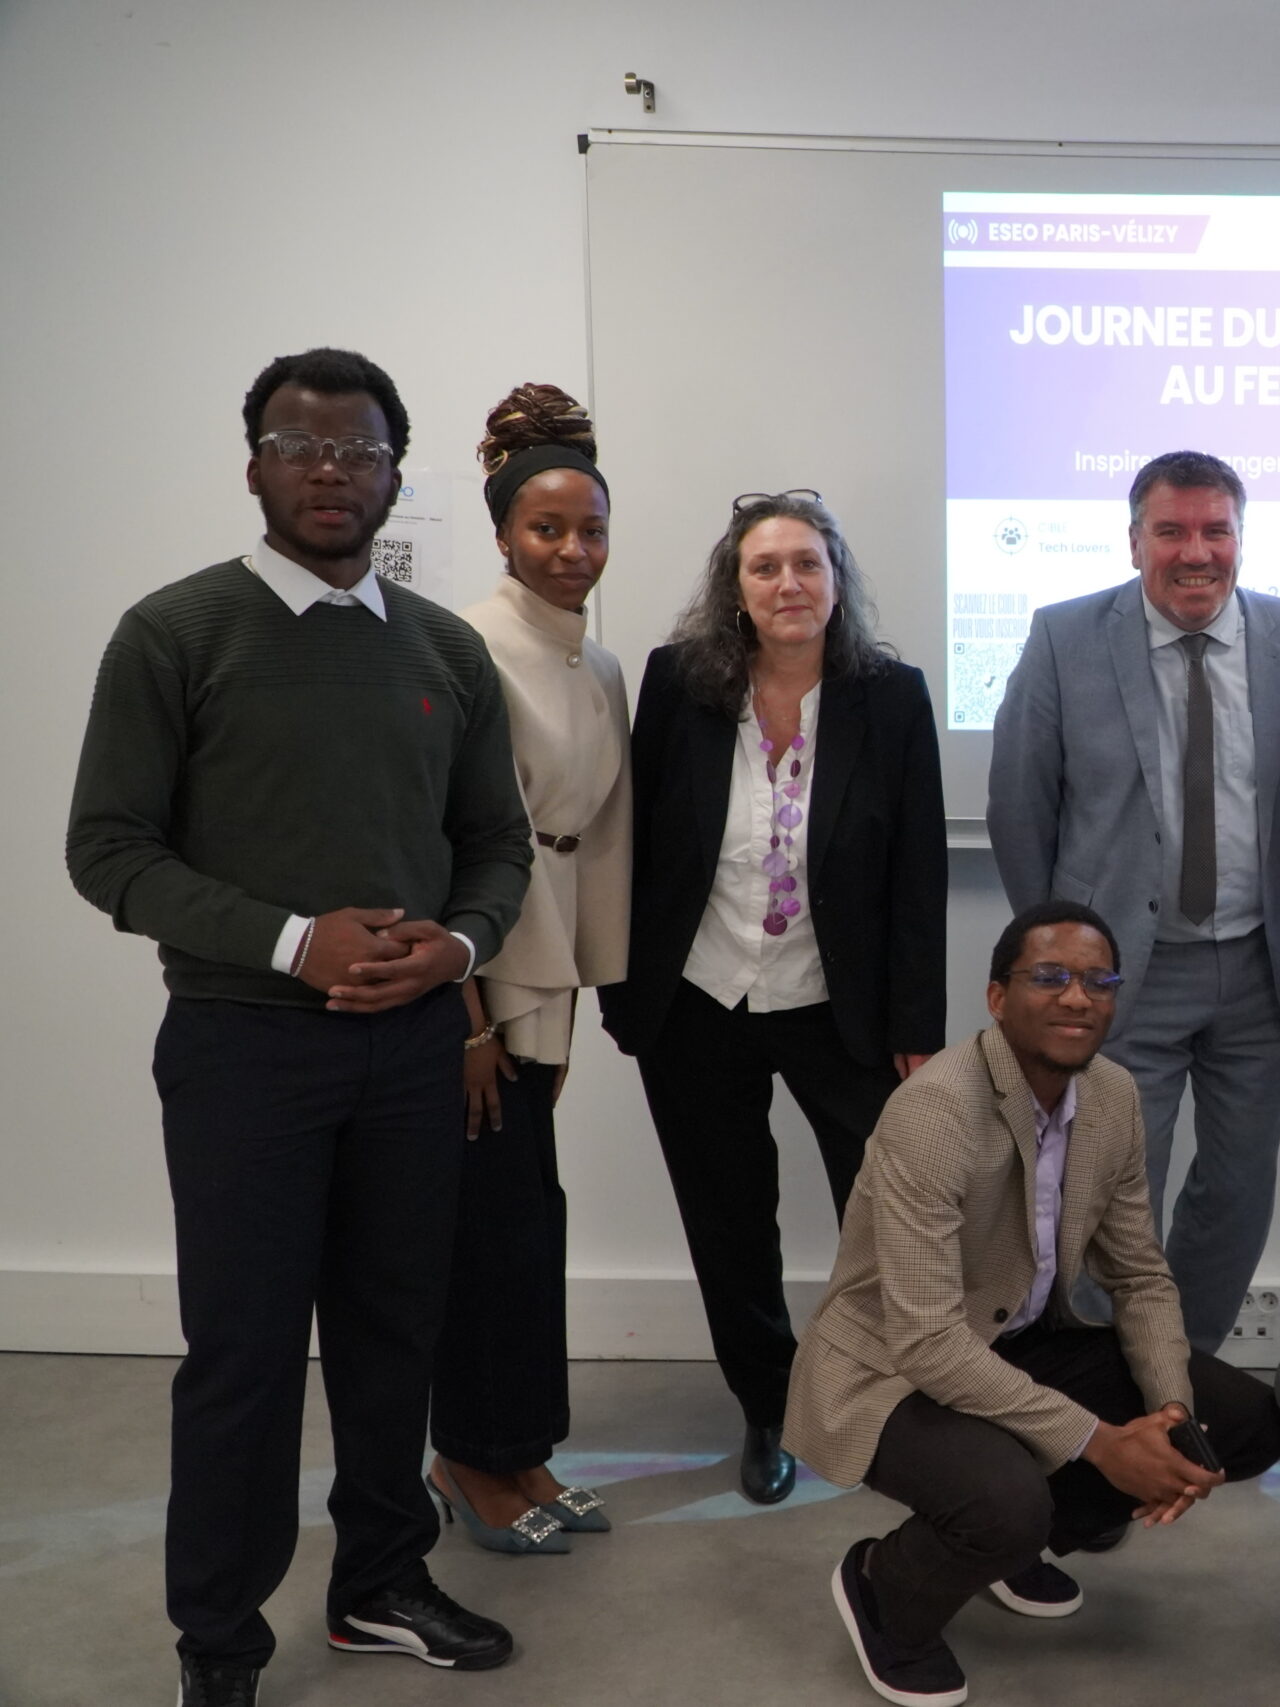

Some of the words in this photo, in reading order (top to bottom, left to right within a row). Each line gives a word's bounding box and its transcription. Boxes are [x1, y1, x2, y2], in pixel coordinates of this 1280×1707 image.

[988, 222, 1038, 241] ESEO
[1043, 219, 1179, 243] PARIS-VÉLIZY
[1009, 305, 1212, 347] JOURNEE
[1159, 365, 1224, 406] AU
[1075, 449, 1157, 478] Inspire
[1038, 542, 1068, 553] Tech
[1071, 542, 1111, 553] Lovers
